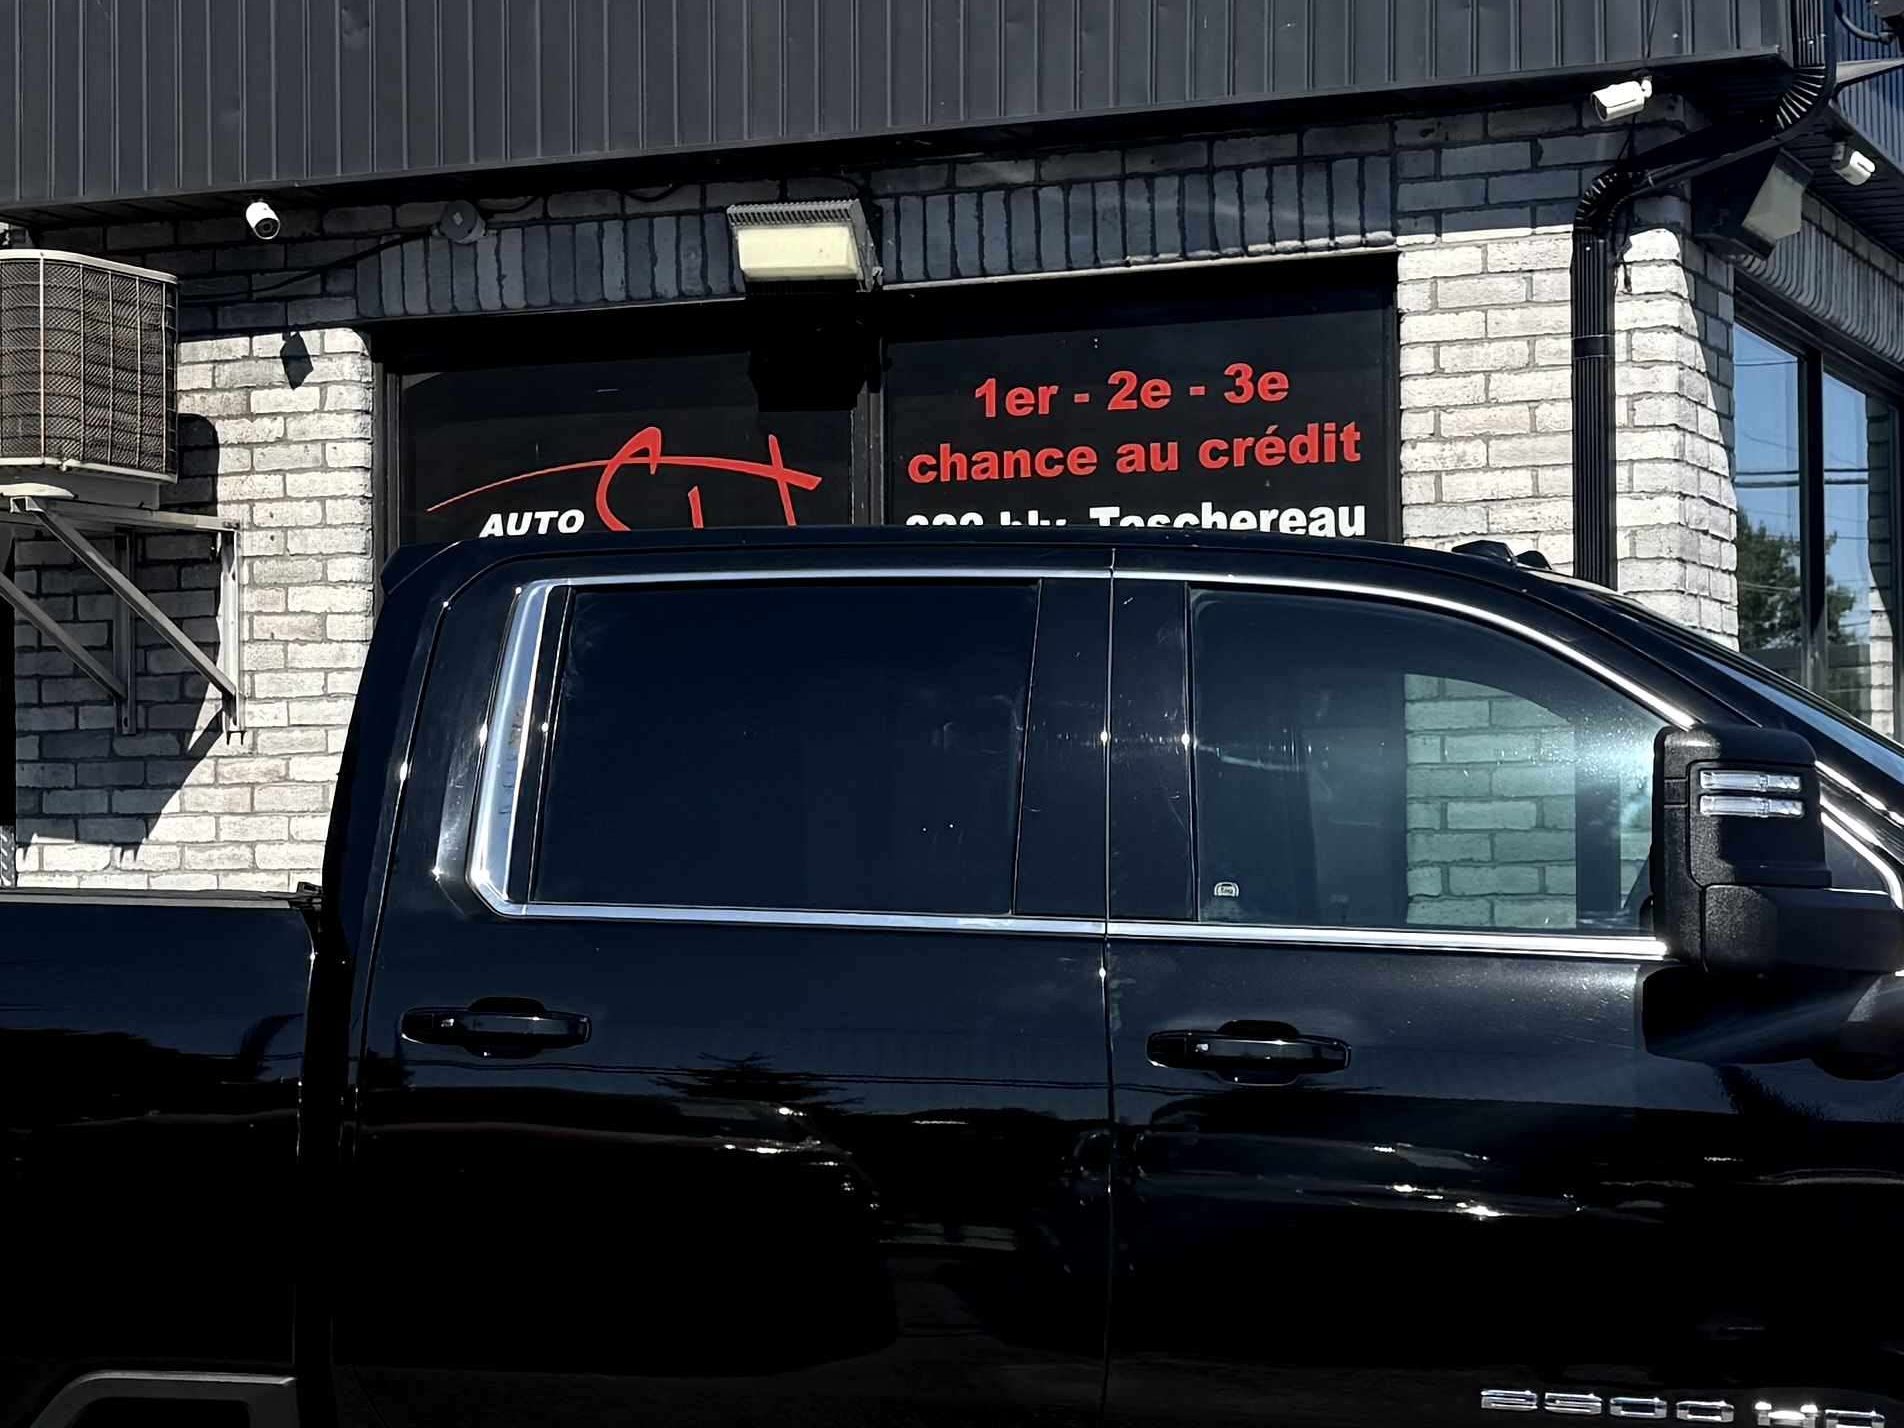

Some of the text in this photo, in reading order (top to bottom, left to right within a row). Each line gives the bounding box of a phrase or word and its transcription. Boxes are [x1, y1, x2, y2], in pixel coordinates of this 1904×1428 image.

[975, 378, 1059, 418] 1er
[1108, 370, 1171, 410] 2e
[1224, 363, 1289, 403] 3e
[908, 421, 1361, 484] chance au crédit
[479, 509, 584, 539] AUTO
[1481, 1389, 1734, 1422] 2500
